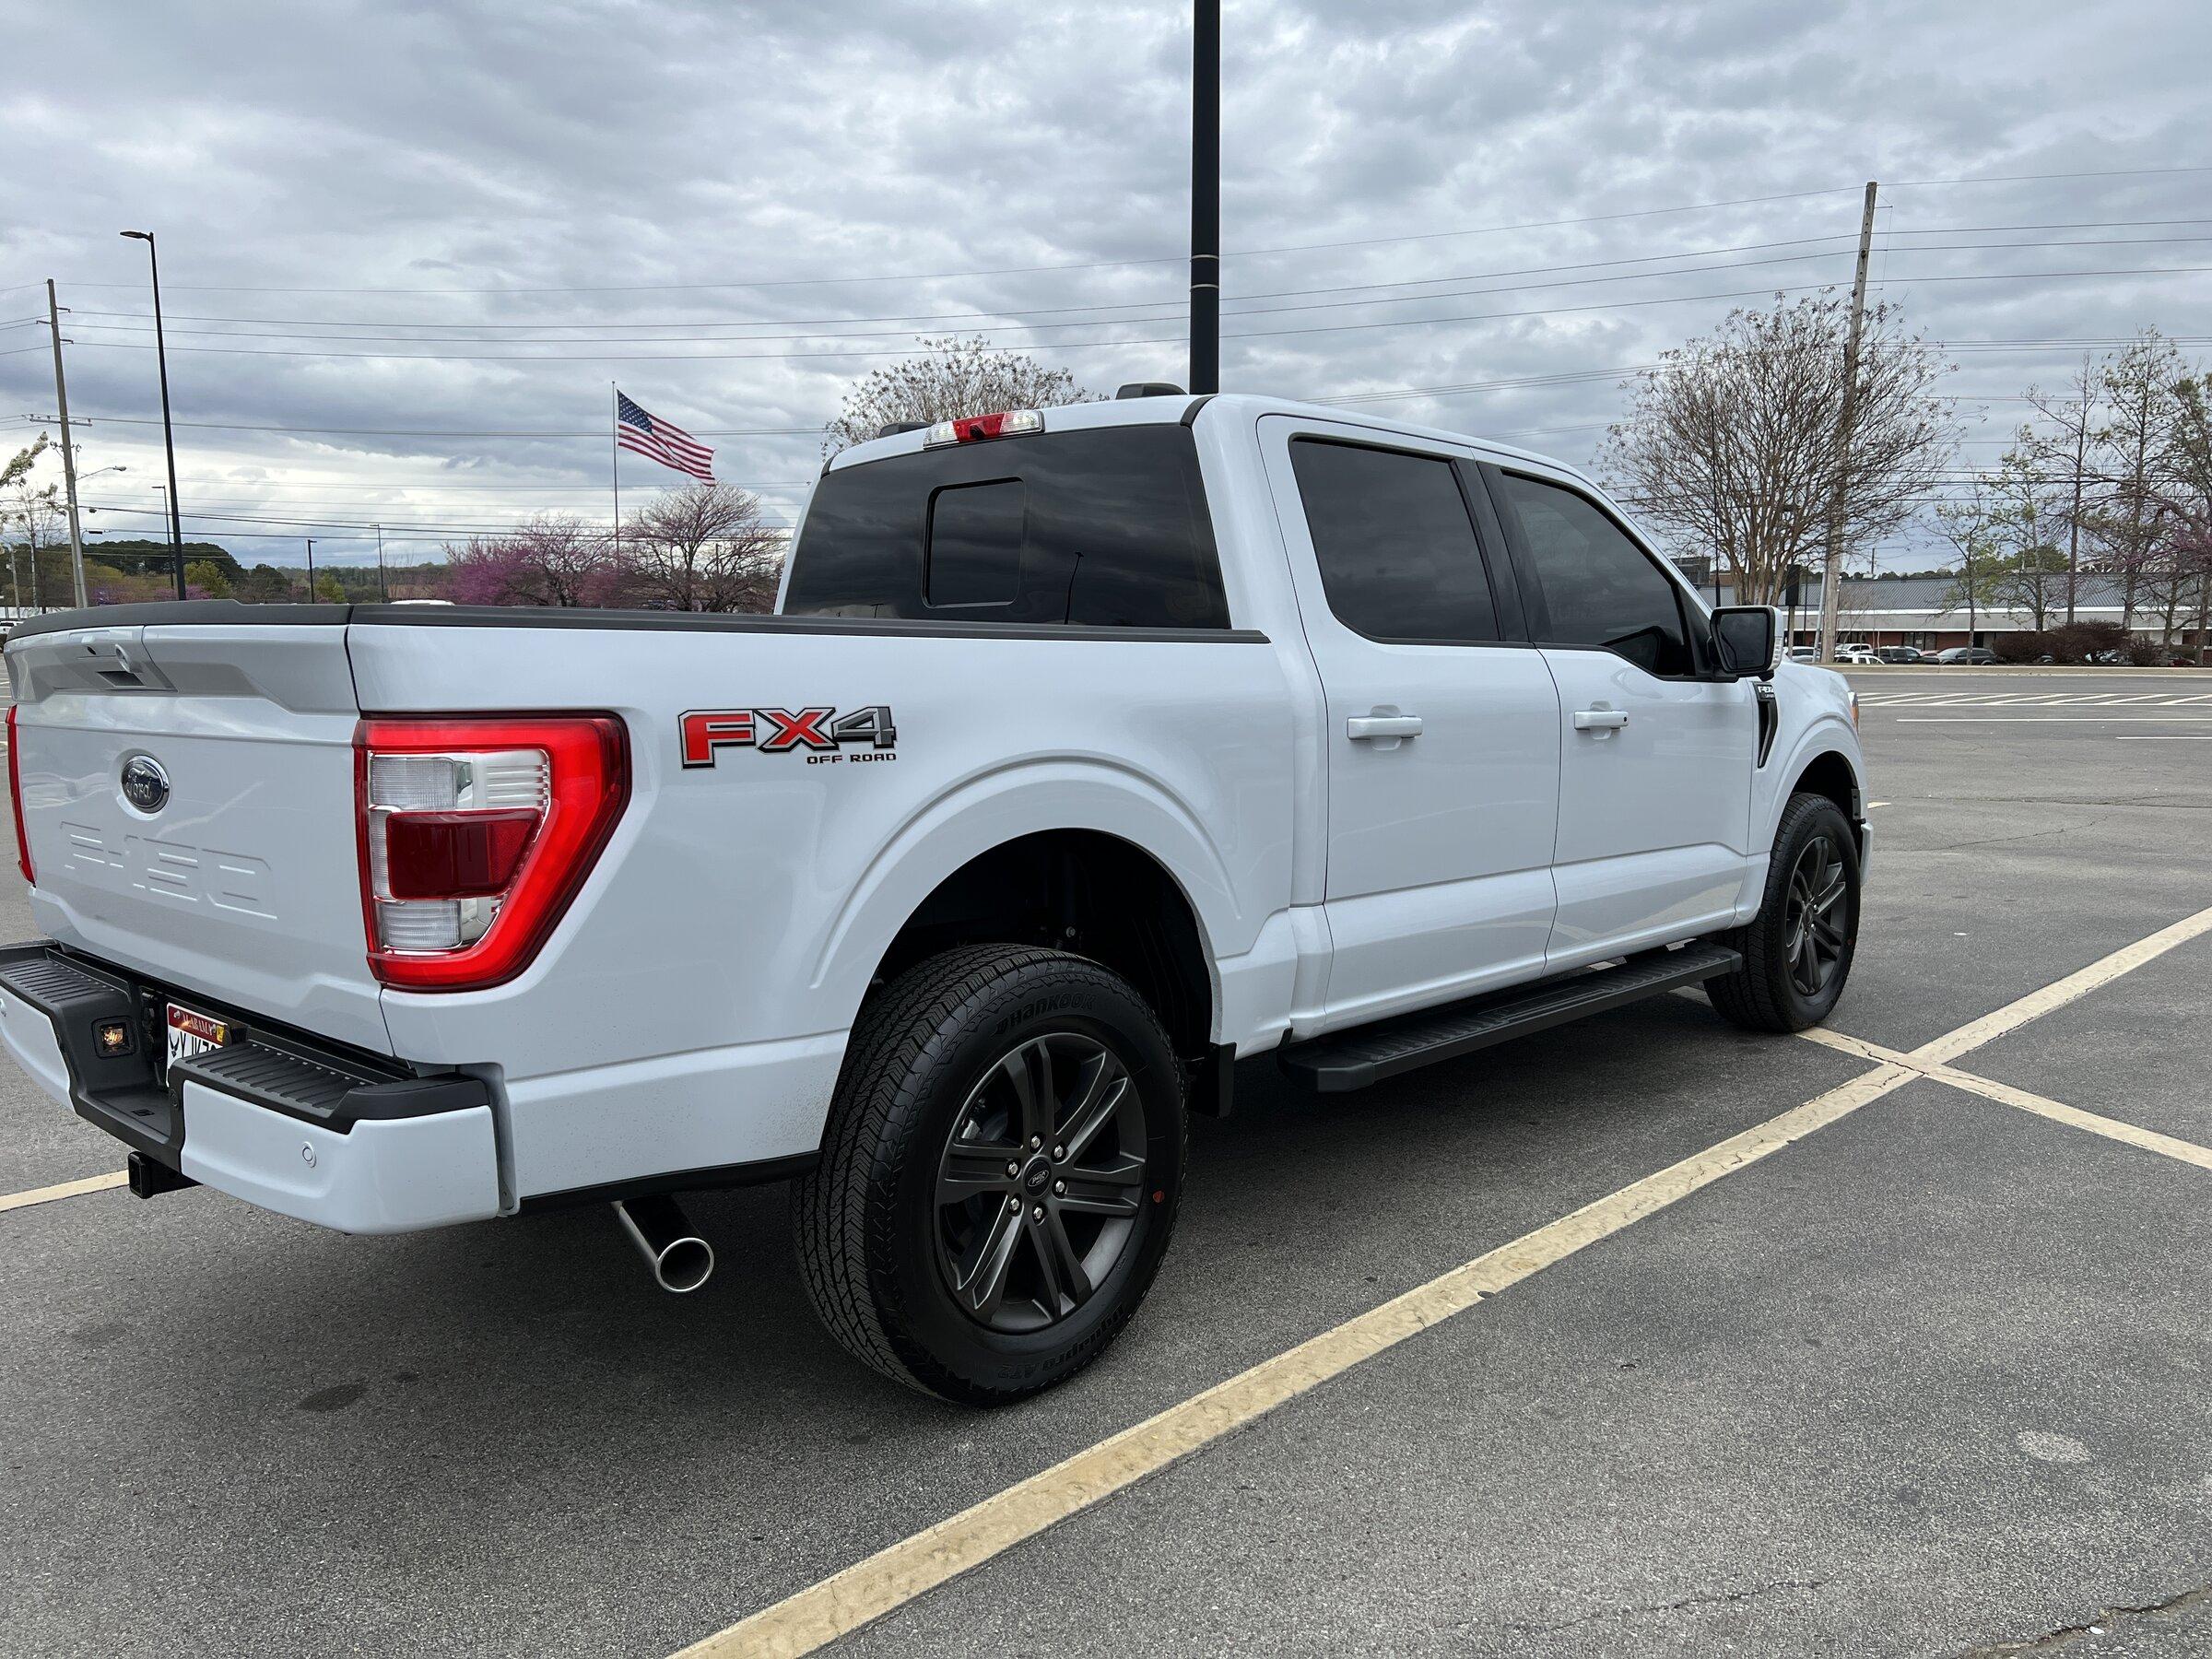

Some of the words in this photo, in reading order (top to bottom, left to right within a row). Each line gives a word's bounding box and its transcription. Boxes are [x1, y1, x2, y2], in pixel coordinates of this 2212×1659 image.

[678, 706, 897, 769] FX4
[806, 755, 842, 764] OFF
[850, 753, 897, 762] ROAD
